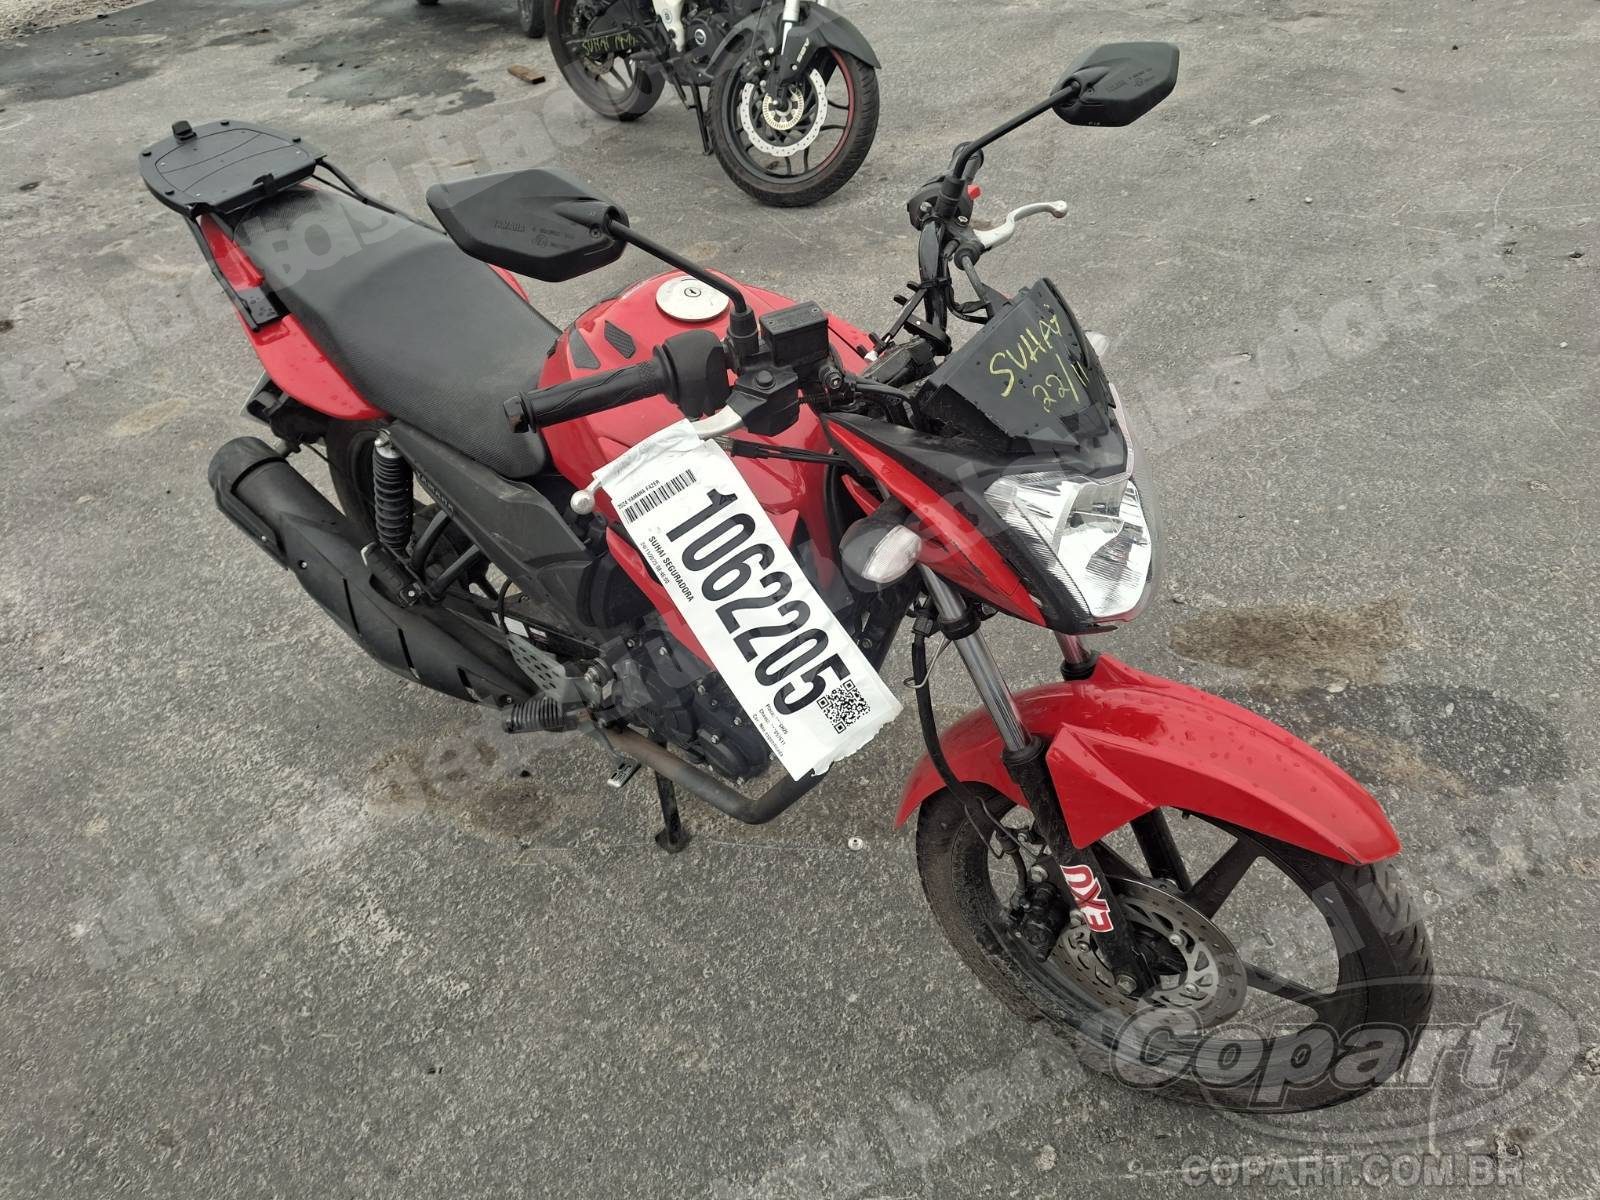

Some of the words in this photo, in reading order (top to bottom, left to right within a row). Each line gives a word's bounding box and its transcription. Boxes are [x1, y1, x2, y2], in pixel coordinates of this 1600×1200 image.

[649, 535, 663, 558] SUHAI
[663, 557, 695, 602] SEGURADORA
[666, 489, 851, 715] 1062205
